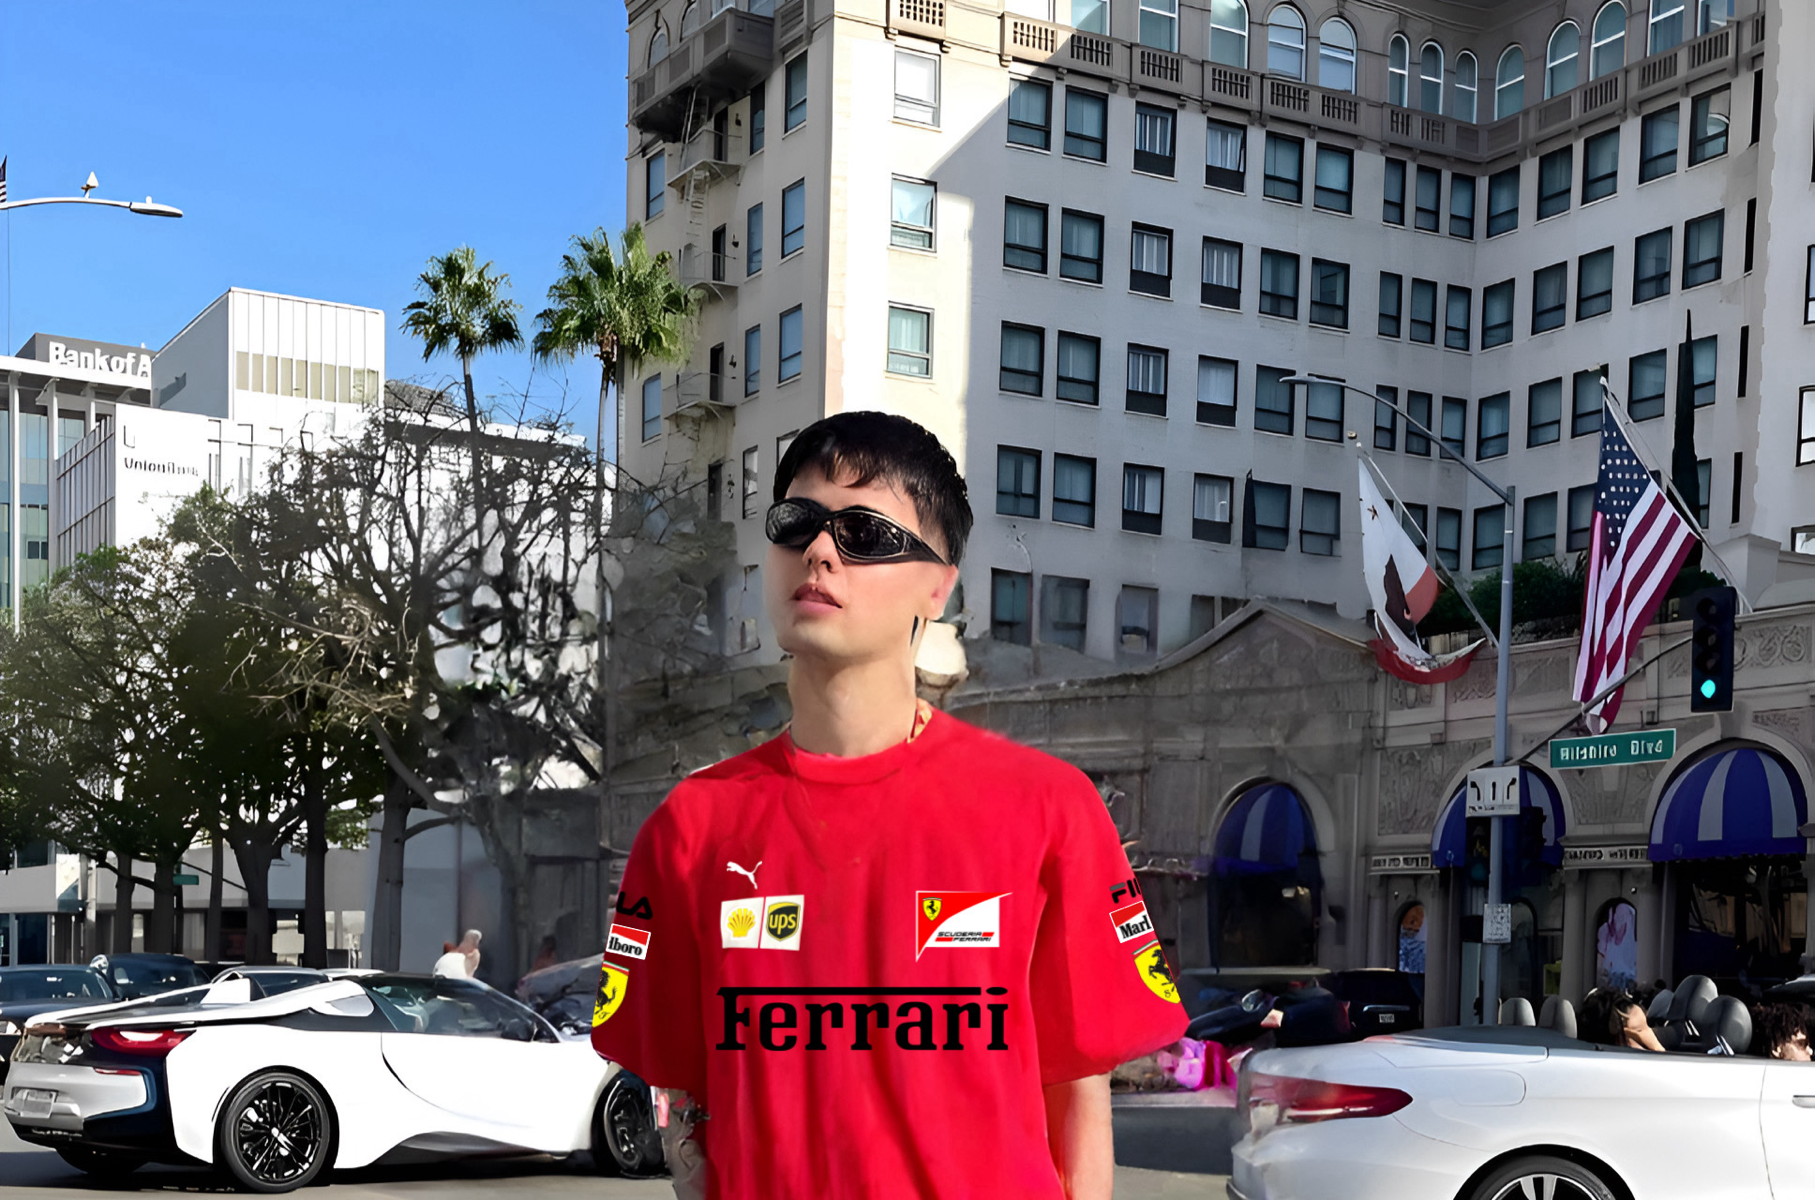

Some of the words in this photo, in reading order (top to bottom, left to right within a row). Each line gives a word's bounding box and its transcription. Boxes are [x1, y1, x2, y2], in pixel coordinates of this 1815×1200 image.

[49, 341, 112, 372] Bank
[110, 352, 136, 375] of
[769, 913, 797, 935] ups
[1119, 914, 1152, 940] Marl
[608, 936, 643, 956] lboro
[715, 986, 1009, 1051] Ferrari
